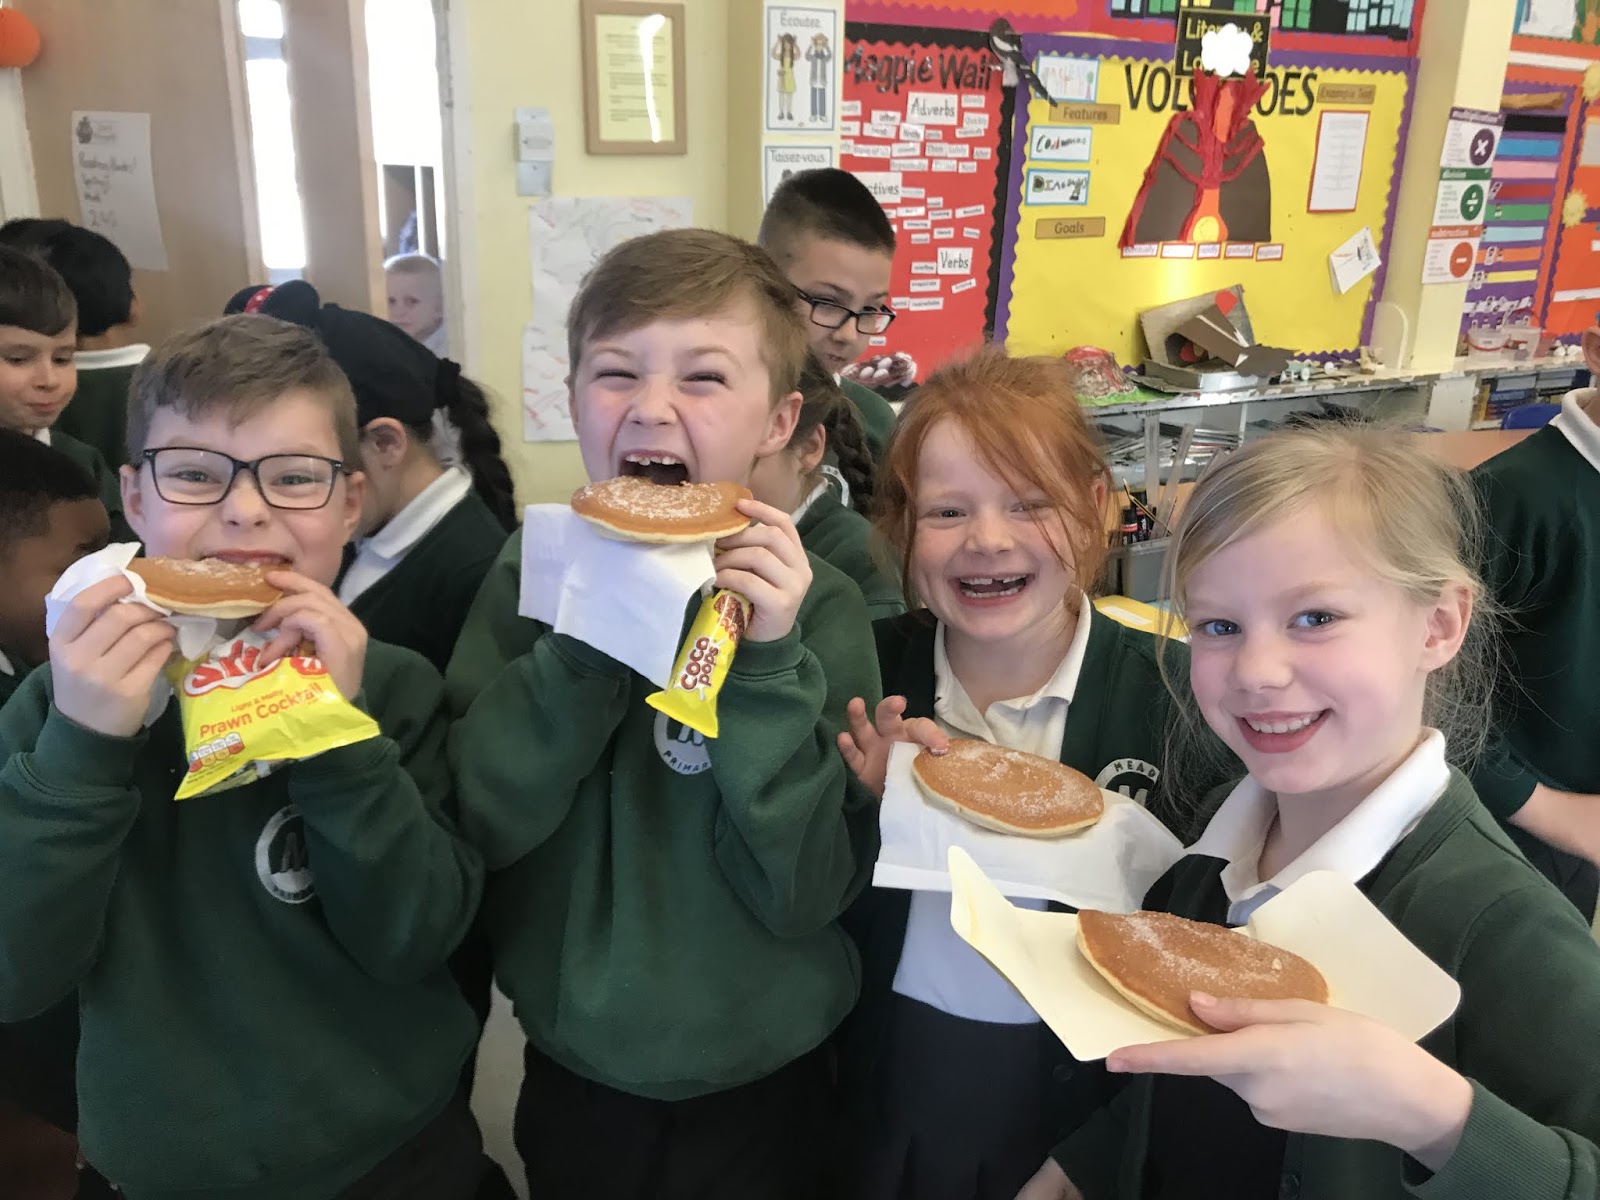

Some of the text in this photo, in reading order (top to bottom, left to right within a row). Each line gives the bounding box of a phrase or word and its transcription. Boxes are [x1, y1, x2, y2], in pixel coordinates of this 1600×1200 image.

[1251, 21, 1264, 43] &
[939, 53, 991, 91] Wall
[1124, 63, 1318, 117] VOLOES
[911, 97, 955, 117] Adverbs
[1063, 106, 1108, 122] Features
[770, 149, 826, 164] Taisez-vous
[867, 182, 899, 195] ctives
[1054, 220, 1085, 235] Goals
[940, 251, 969, 269] Verbs
[698, 645, 719, 687] pops
[200, 682, 325, 738] Prawn Cocktail
[231, 699, 253, 713] Light
[663, 750, 709, 771] PRIMAR
